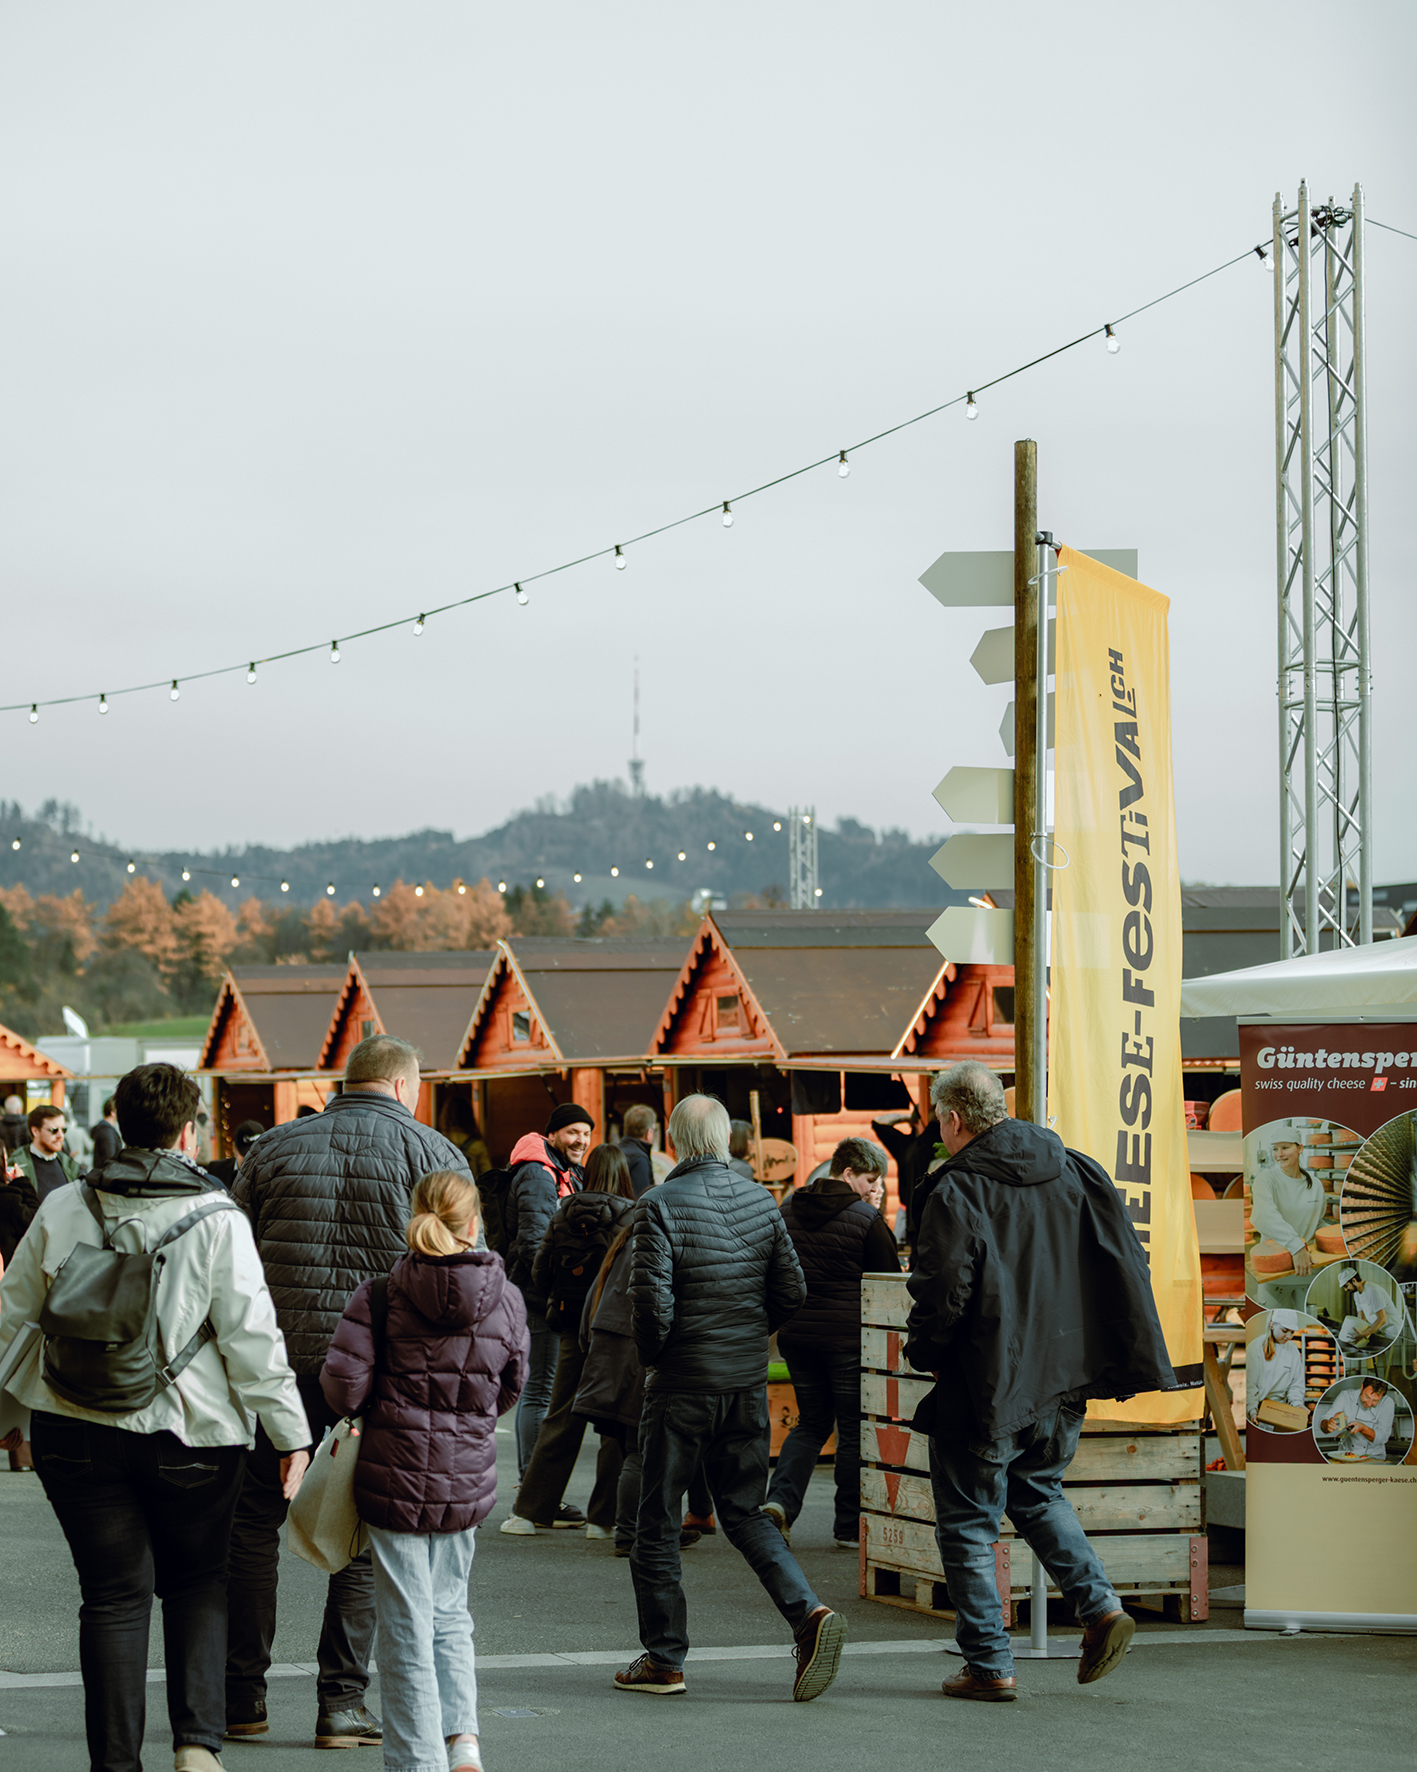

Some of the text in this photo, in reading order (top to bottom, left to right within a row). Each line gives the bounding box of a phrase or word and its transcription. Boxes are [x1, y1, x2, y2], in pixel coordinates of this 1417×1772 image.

[1255, 1078, 1283, 1090] swiss
[1286, 1077, 1324, 1092] quality
[1327, 1077, 1366, 1089] cheese
[1399, 1077, 1417, 1089] sin
[1322, 1476, 1417, 1485] www.guentensperger-kaese.ch
[883, 1527, 904, 1545] 5259
